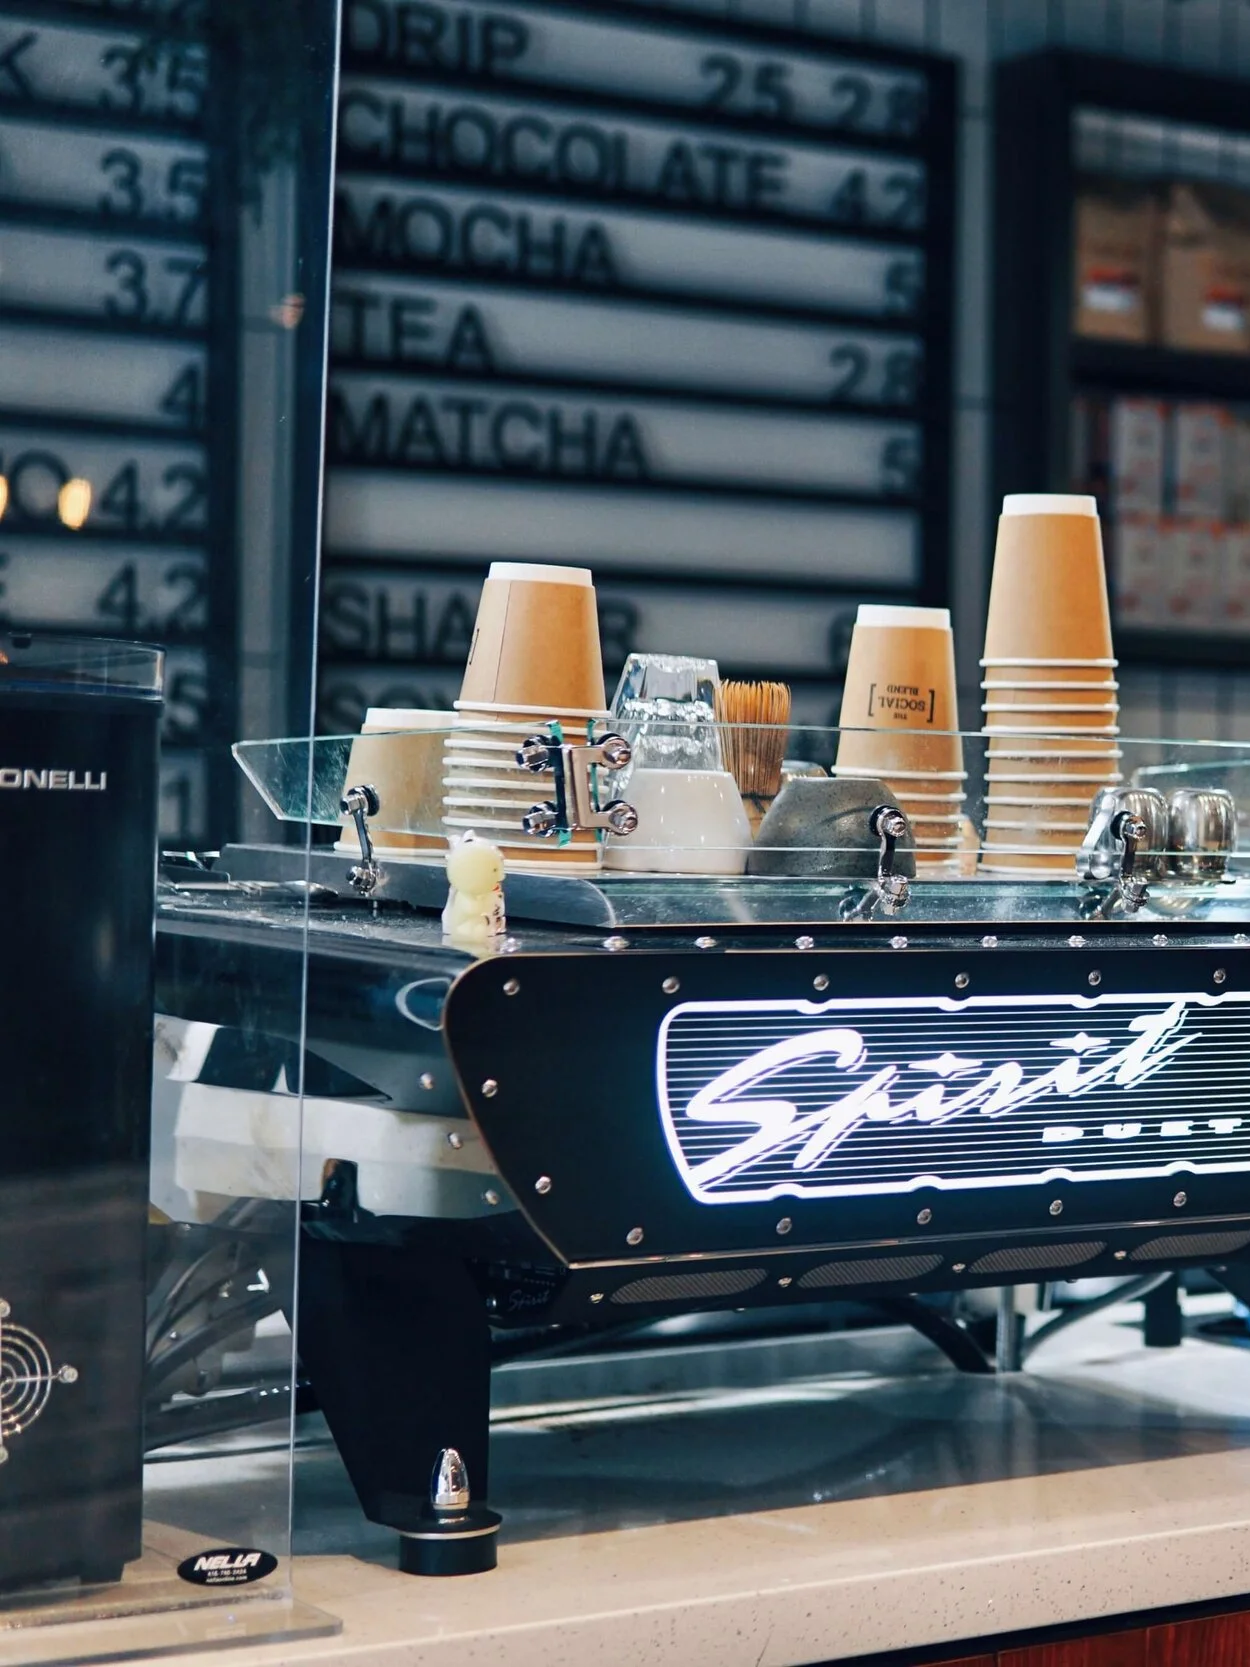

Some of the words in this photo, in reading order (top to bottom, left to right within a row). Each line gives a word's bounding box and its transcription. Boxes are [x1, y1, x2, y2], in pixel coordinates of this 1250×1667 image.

[344, 0, 530, 74] DRIP
[337, 88, 792, 212] CHOCOLATE
[336, 190, 620, 286] MOCHA
[332, 288, 498, 370] TEA
[328, 388, 652, 476] MATCHA
[324, 580, 642, 662] SHAR
[878, 696, 926, 712] SOCIAL
[886, 684, 919, 696] BLEND
[686, 1002, 1202, 1190] Spirit
[193, 1552, 262, 1571] NELLA
